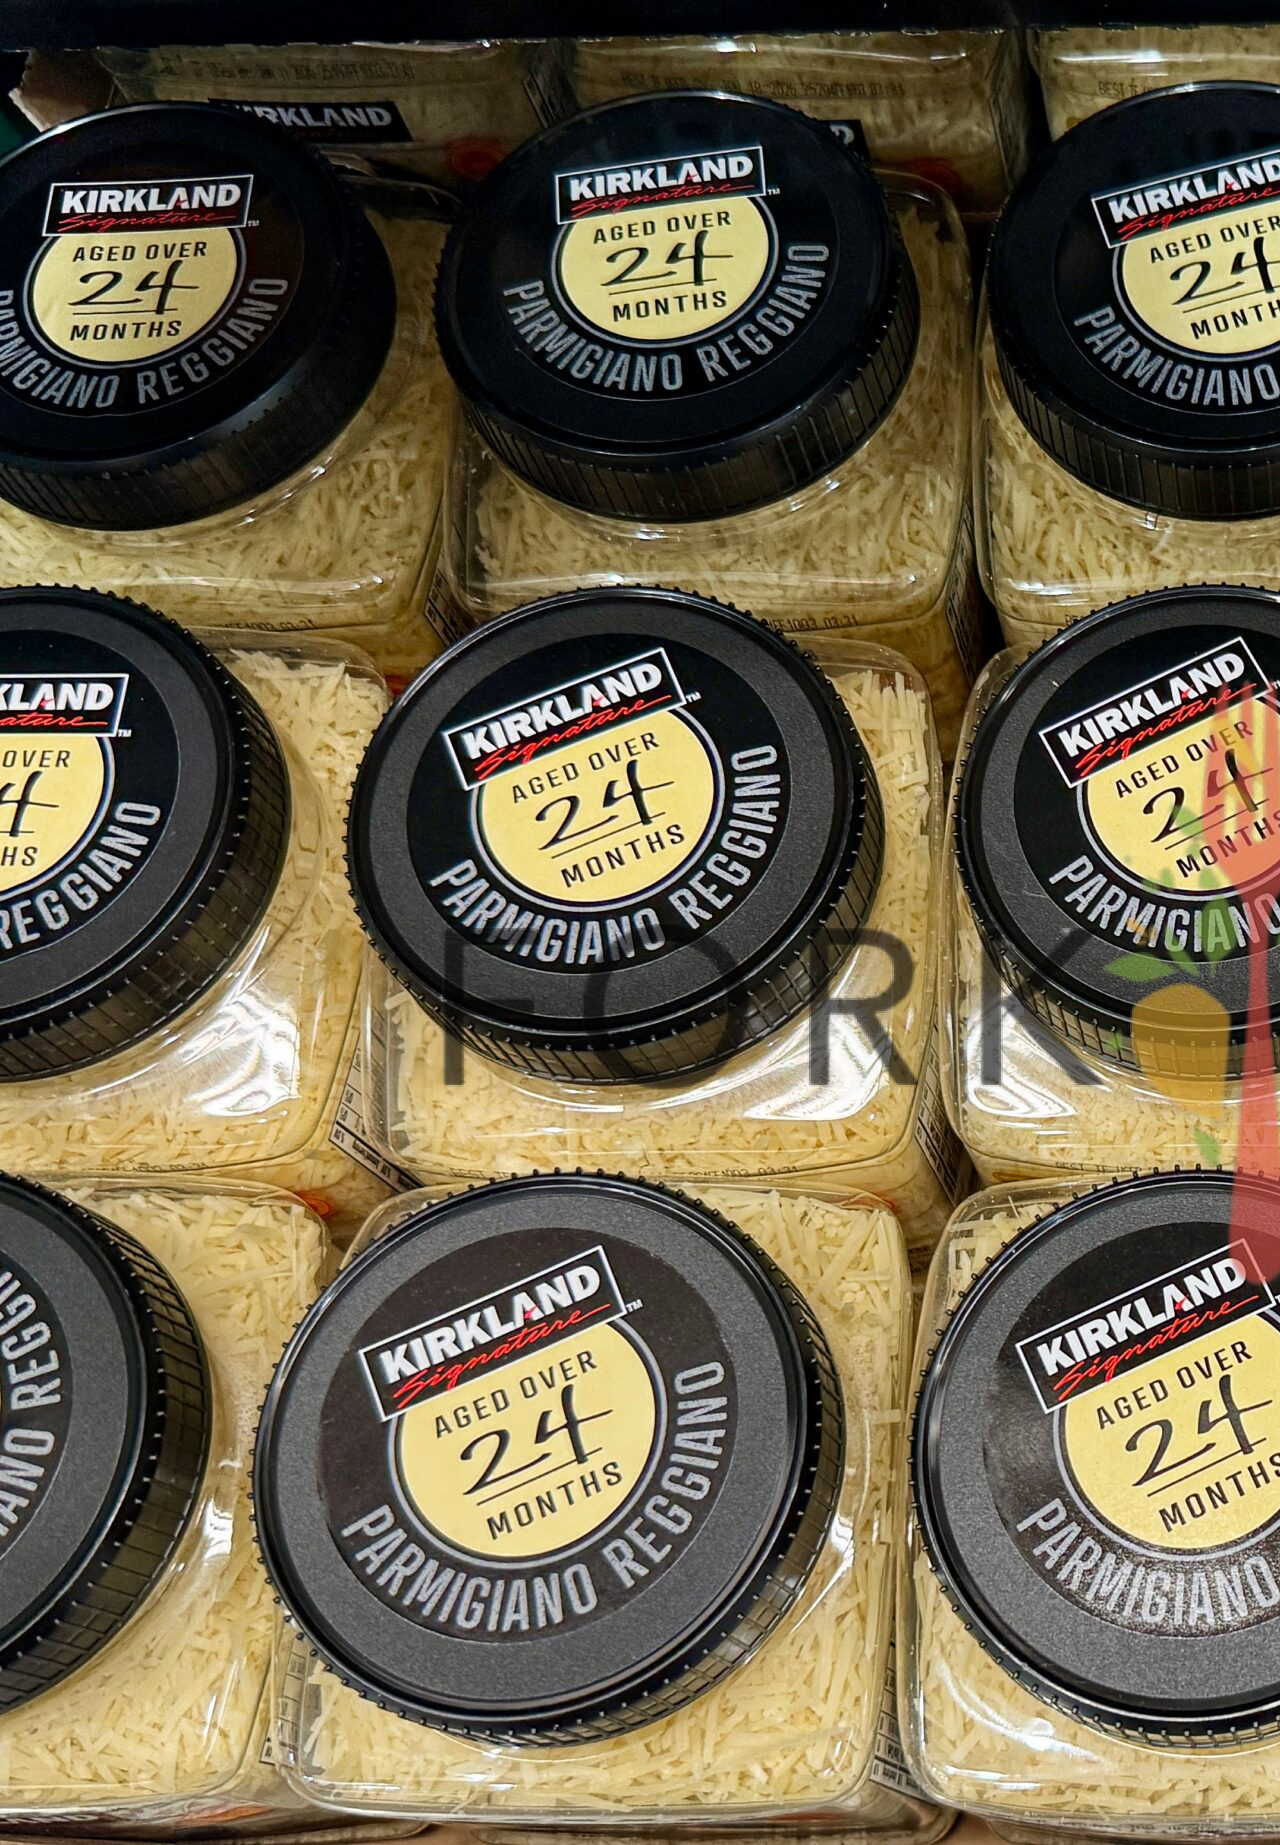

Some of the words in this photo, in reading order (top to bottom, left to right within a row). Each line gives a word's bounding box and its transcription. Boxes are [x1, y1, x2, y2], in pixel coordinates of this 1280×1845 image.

[60, 183, 241, 213] KIRKLAND
[569, 186, 755, 220] Signature
[570, 156, 753, 201] KIRKLAND
[57, 212, 236, 233] Signature
[73, 246, 135, 262] AGED
[146, 241, 207, 259] OVER
[593, 220, 656, 244] AGED
[667, 211, 732, 232] OVER
[601, 229, 734, 286] 24
[1150, 233, 1211, 263] AGED
[68, 260, 199, 315] 24
[70, 321, 182, 340] MONTHS
[504, 280, 683, 392] PARMIGIANO
[696, 244, 829, 382] REGGIANO
[613, 291, 727, 322] MONTHS
[137, 279, 288, 404] REGGIANO
[1074, 304, 1280, 406] PARMIGIANO
[825, 615, 859, 629] 03:31
[0, 712, 107, 726] ature
[462, 663, 662, 761] KIRKLAND
[473, 694, 672, 780] Signature
[1058, 653, 1244, 757] KIRKLAND
[1076, 682, 1257, 777] Signature
[2, 750, 71, 767] OVER
[512, 762, 580, 804] AGED
[590, 732, 660, 771] OVER
[1114, 754, 1180, 799] AGED
[1189, 720, 1254, 762] OVER
[1142, 748, 1274, 843] 24
[0, 771, 59, 837] 4
[535, 760, 675, 851] 24
[430, 858, 666, 965] PARMIGIANO
[669, 745, 781, 929] REGGIANO
[560, 823, 686, 888] MONTHS
[379, 1265, 601, 1385] KIRKLAND
[391, 1304, 611, 1410] Signature
[1036, 1257, 1246, 1377] KIRKLAND
[1052, 1296, 1259, 1401] Signature
[434, 1389, 510, 1438] AGED
[520, 1350, 598, 1398] OVER
[1097, 1378, 1169, 1429] AGED
[1177, 1341, 1253, 1388] OVER
[460, 1384, 613, 1496] 24
[1125, 1374, 1273, 1488] 24
[341, 1505, 598, 1632] PARMIGIANO
[602, 1361, 728, 1589] REGGIANO
[486, 1461, 623, 1540] MONTHS
[1016, 1497, 1280, 1626] PARMIGIANO
